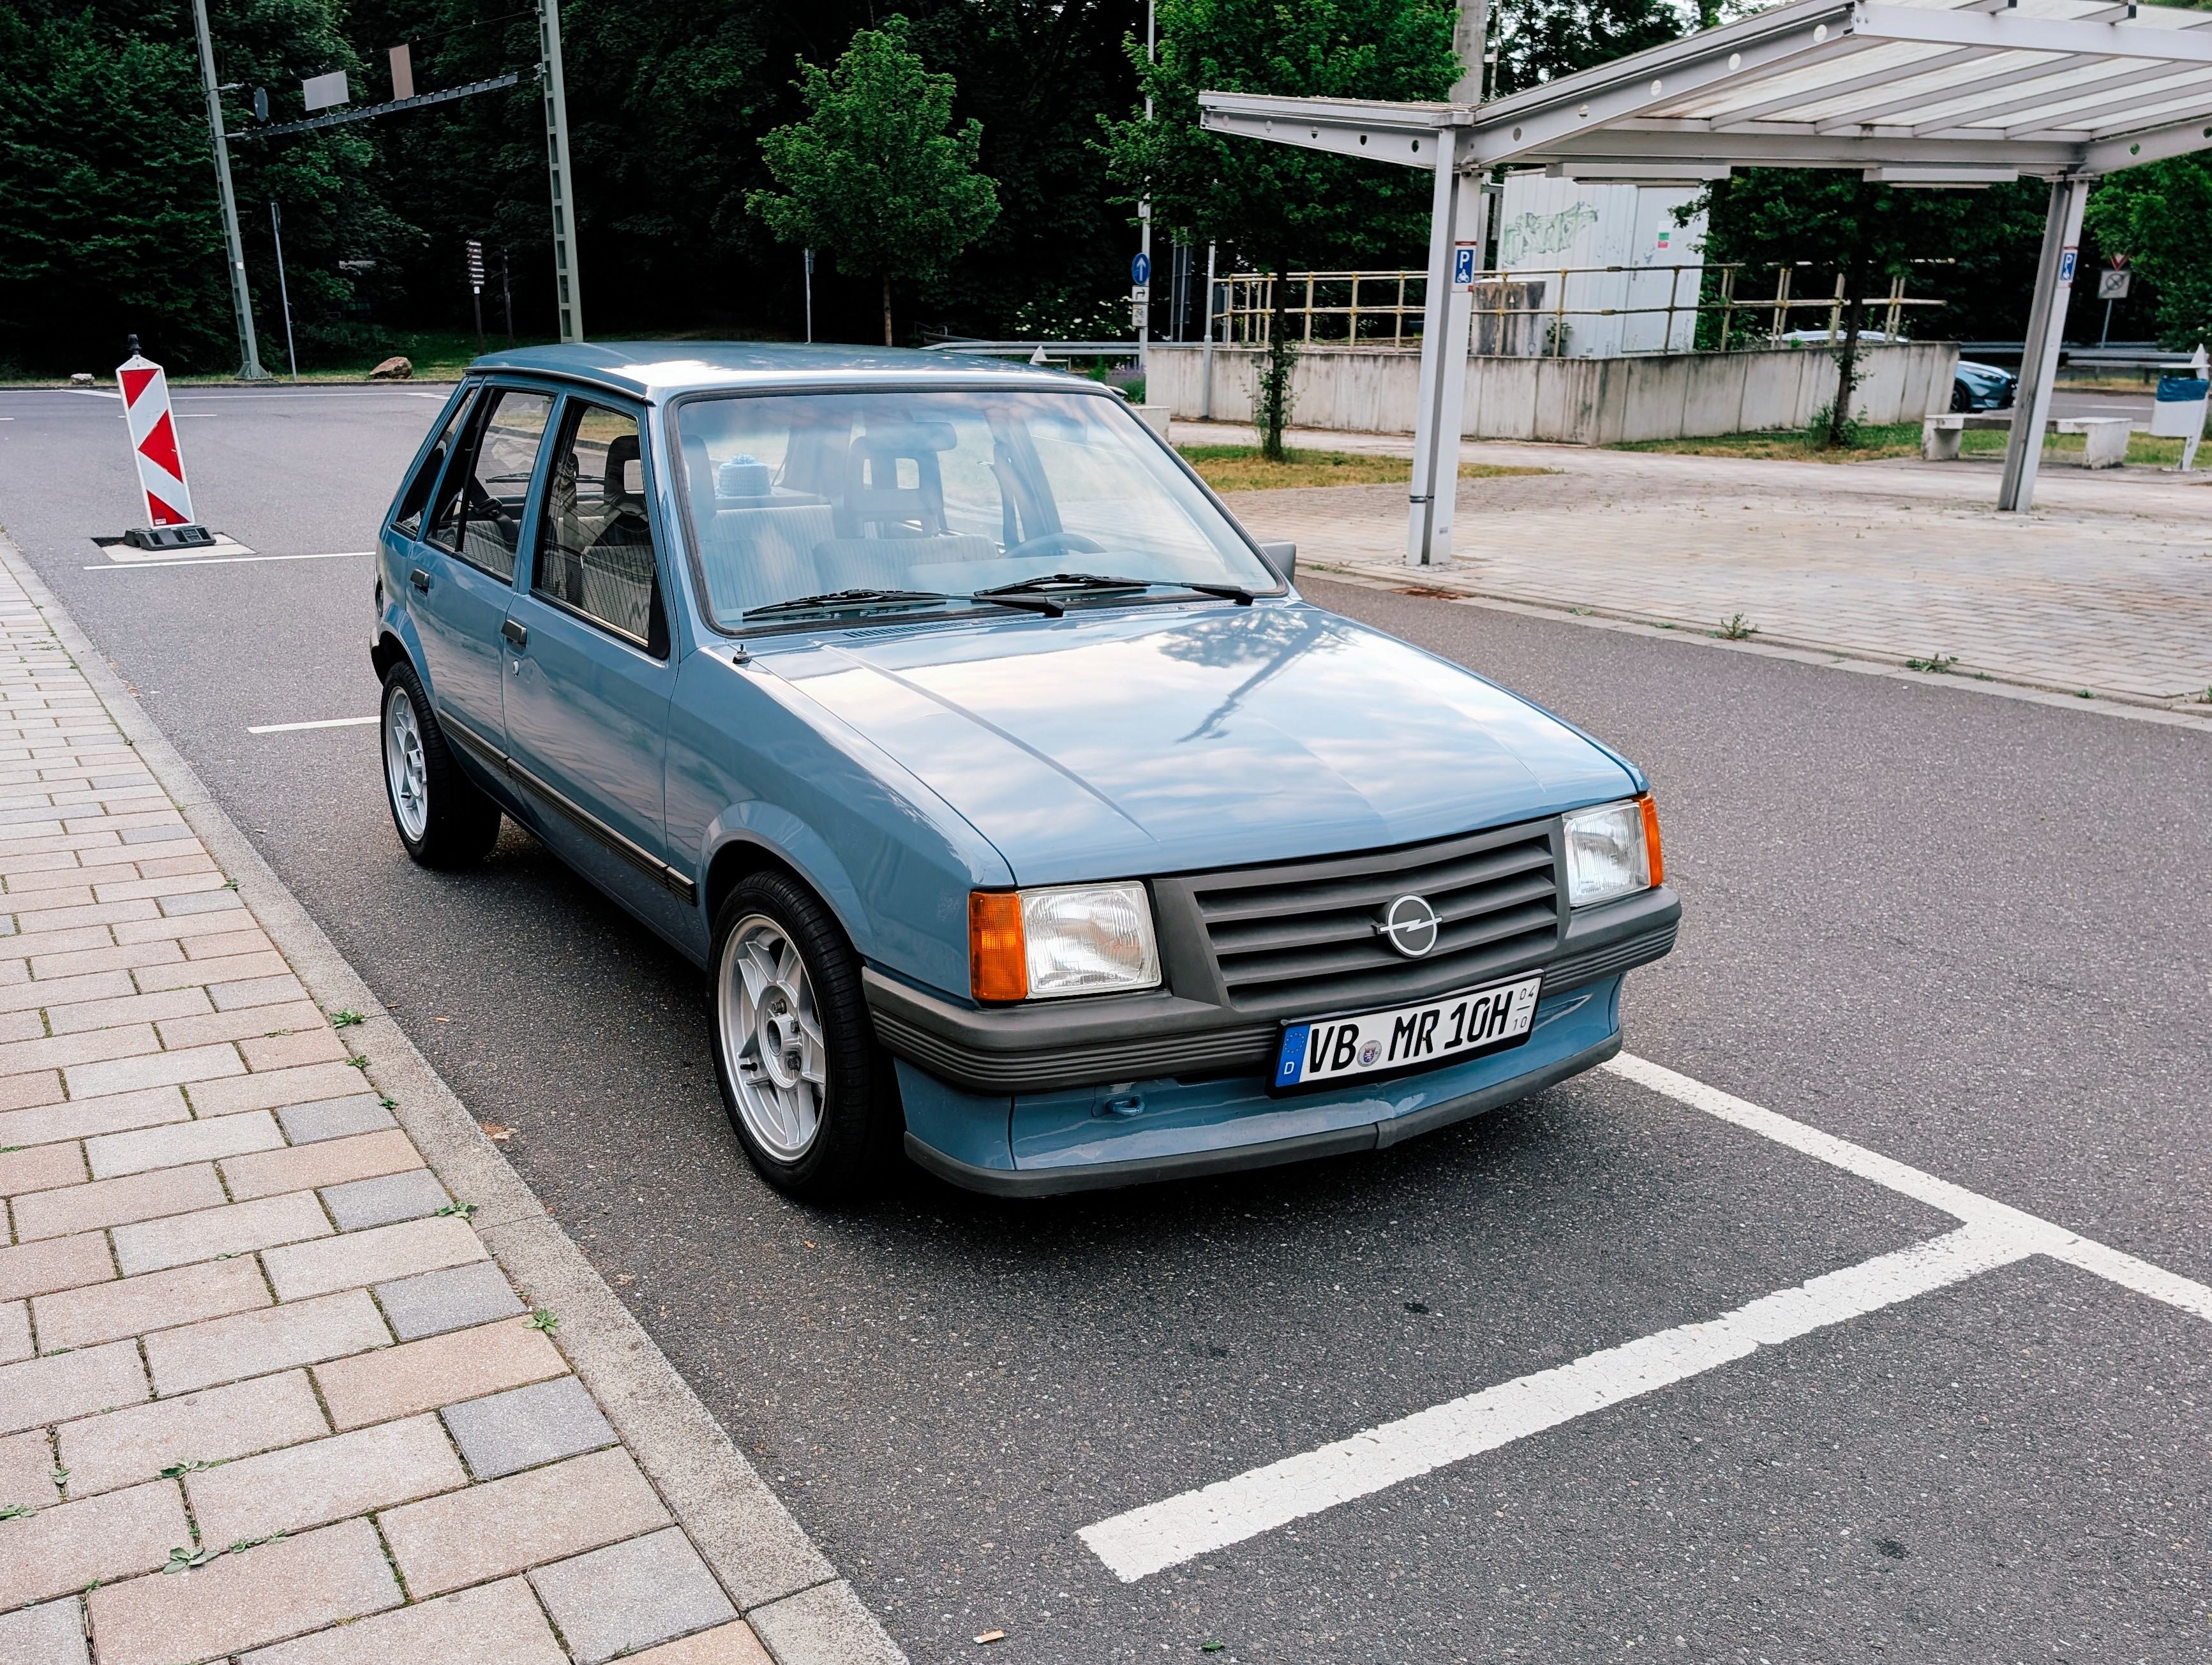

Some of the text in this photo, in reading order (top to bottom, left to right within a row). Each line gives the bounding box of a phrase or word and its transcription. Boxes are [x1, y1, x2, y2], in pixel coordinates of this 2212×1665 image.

[1460, 251, 1470, 269] P
[2065, 254, 2074, 269] P
[1519, 985, 1536, 1001] 04
[1513, 1016, 1528, 1031] 10
[1309, 990, 1514, 1073] VB MR 10H
[1283, 1061, 1295, 1075] D
